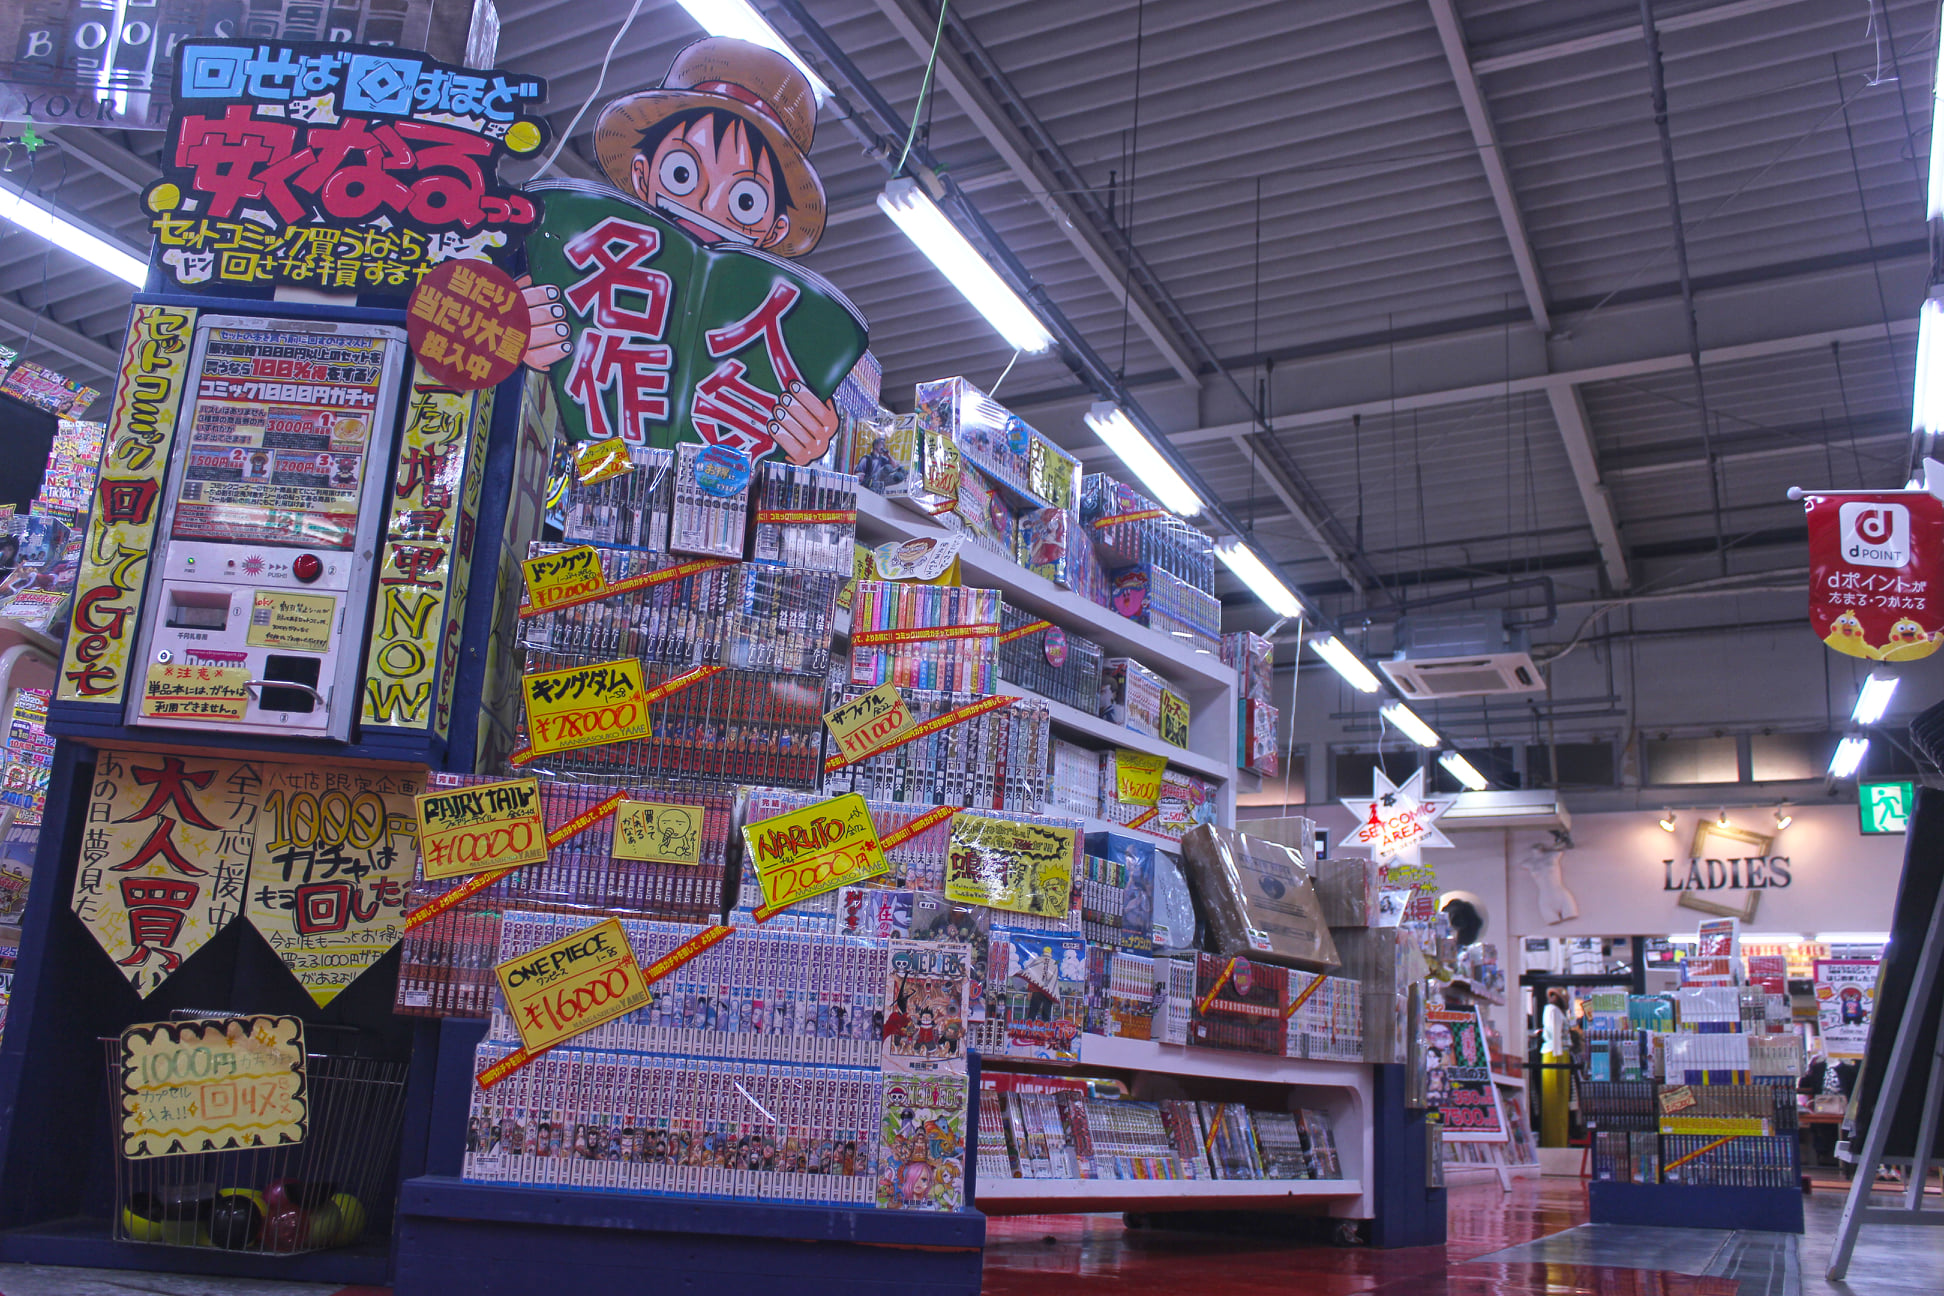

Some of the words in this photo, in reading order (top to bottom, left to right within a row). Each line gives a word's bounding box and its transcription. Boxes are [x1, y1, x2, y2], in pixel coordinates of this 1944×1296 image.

[181, 45, 538, 120] 回せば回すほど
[22, 92, 116, 121] YOUR
[152, 213, 427, 260] セットコミック買うなら
[450, 266, 517, 312] 当たり
[411, 285, 527, 364] 当たり大量
[563, 216, 673, 446] 名作
[420, 330, 492, 381] 投入中
[200, 381, 376, 405] コミック1000円ガチャ
[267, 420, 313, 433] 3000円
[190, 455, 228, 468] 1500円
[275, 460, 314, 473] 1200円
[531, 551, 593, 583] ドンケツ
[1849, 545, 1860, 558] d
[1862, 549, 1902, 561] POINT
[1827, 571, 1927, 593] dポイントが
[1828, 592, 1927, 610] たまる・つかえる
[533, 668, 634, 704] キングダム
[536, 704, 637, 743] ¥28000
[559, 732, 619, 747] MANGASOUKO
[620, 725, 646, 738] YAME
[265, 790, 418, 851] 1000円
[645, 809, 655, 840] 買って
[1388, 801, 1436, 829] COMIC
[77, 753, 124, 922] あの日夢見た
[208, 764, 262, 937] 全力応援中
[428, 822, 533, 866] ¥10000
[758, 816, 845, 861] NARUTO
[1383, 822, 1424, 847] AREA
[272, 844, 397, 881] ガチャは
[517, 848, 543, 860] YAME
[109, 756, 222, 989] 大人買い
[795, 871, 857, 897] MANGASOUKO
[855, 860, 884, 877] YAME
[1663, 856, 1791, 890] LADIES
[507, 950, 553, 988] ONE
[554, 932, 607, 978] PIECE
[536, 968, 568, 985] ワンピース
[620, 991, 646, 1010] YAME
[142, 1048, 237, 1084] 1000円
[141, 1087, 192, 1103] カプセル
